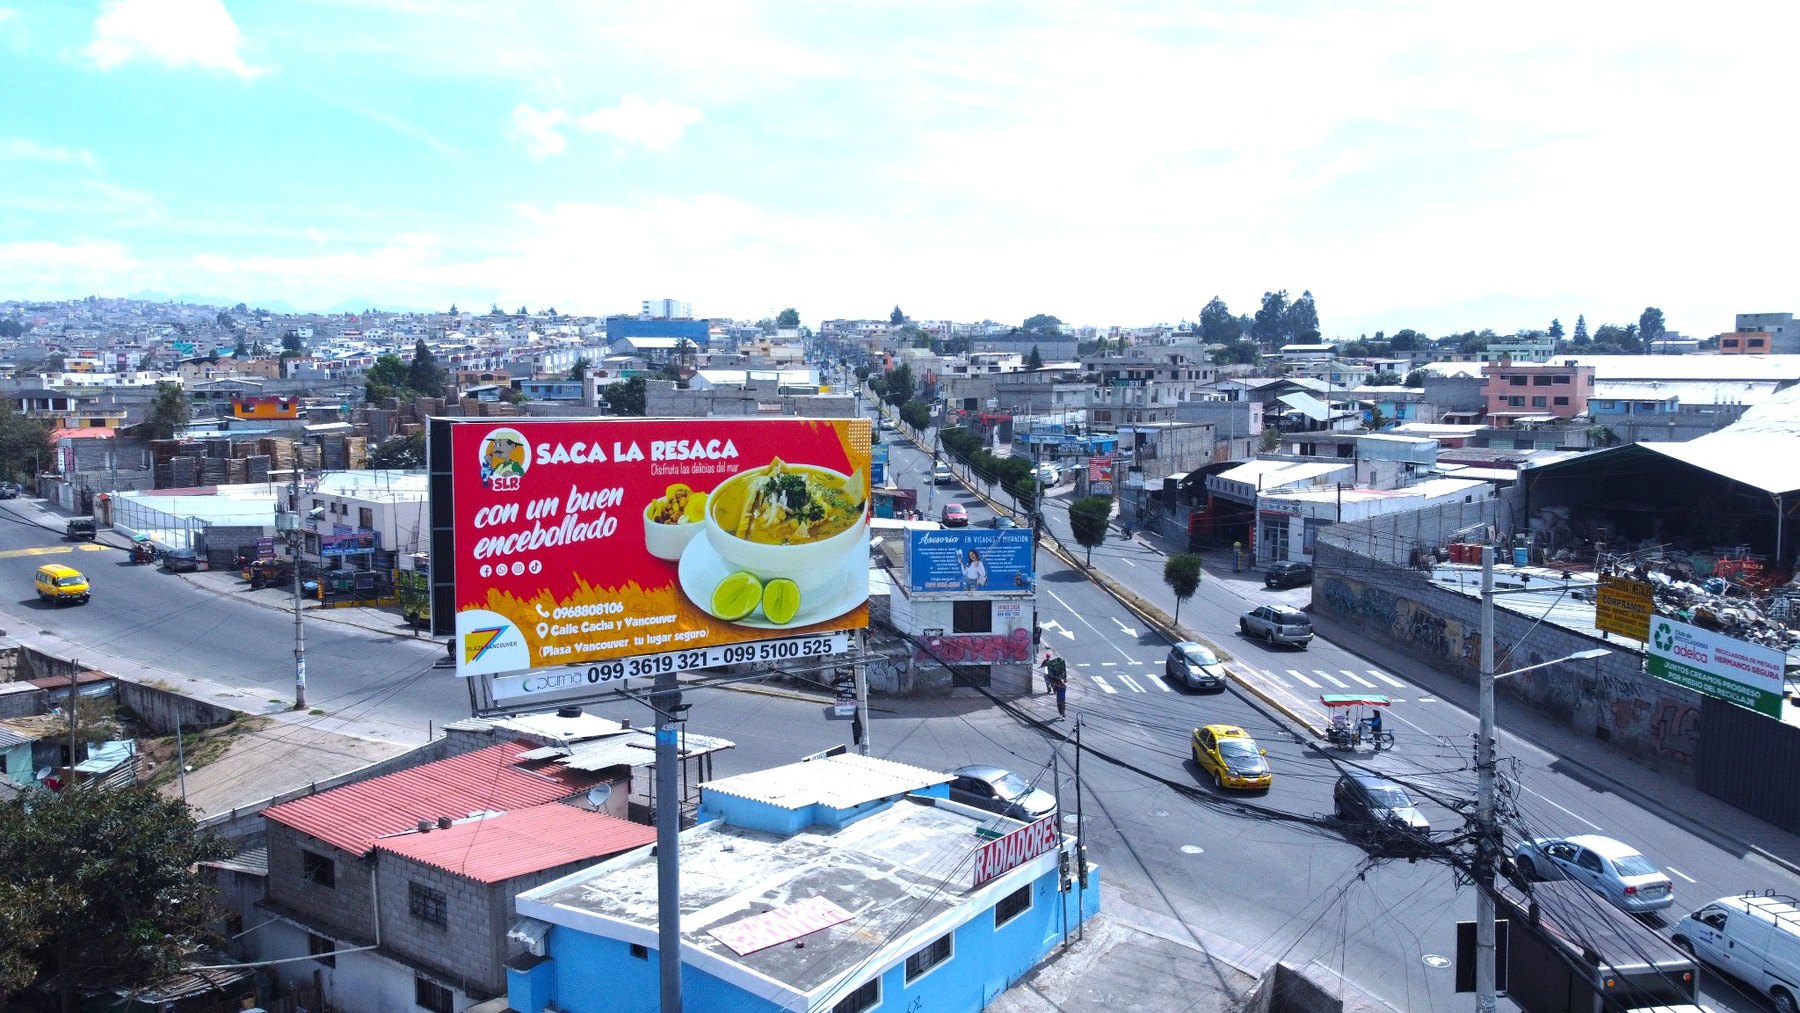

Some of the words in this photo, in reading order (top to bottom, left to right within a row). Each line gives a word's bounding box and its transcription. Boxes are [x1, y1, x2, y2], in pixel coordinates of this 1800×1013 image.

[536, 441, 608, 465] SACA
[613, 440, 645, 463] LA
[651, 438, 739, 462] RESACA
[651, 462, 679, 476] Disfruta
[680, 462, 690, 474] las
[691, 461, 715, 474] delicias
[716, 461, 726, 473] del
[726, 464, 740, 472] mar
[494, 477, 519, 490] SLR
[473, 503, 519, 529] con
[525, 496, 560, 521] un
[565, 484, 624, 513] buen
[473, 511, 618, 560] encebollado
[964, 535, 972, 543] EN
[552, 601, 624, 619] 0968808106
[1602, 595, 1646, 614] COMPRAMOS
[550, 623, 579, 637] Calle
[581, 619, 614, 633] Cacha
[616, 621, 622, 631] y
[624, 613, 677, 628] Vancouver
[633, 635, 644, 646] tu
[646, 633, 672, 645] lugar
[587, 662, 624, 683] 099
[628, 655, 673, 677] 3619
[677, 651, 708, 670] 321
[723, 645, 756, 664] 099
[760, 641, 799, 660] 5100
[803, 638, 832, 655] 525
[1673, 644, 1708, 664] adelca
[1757, 659, 1780, 671] METALES
[1664, 661, 1690, 675] JUNTOS
[1689, 669, 1722, 686] CREAMOS
[1722, 680, 1761, 699] PROGRESO
[1714, 655, 1751, 672] HERMANOS
[1752, 666, 1780, 681] SEGURA
[1668, 671, 1681, 681] POR
[1682, 676, 1703, 689] MEDIO
[1704, 683, 1716, 693] DEL
[1717, 688, 1756, 707] RECICLAJE
[974, 813, 1058, 885] RADIADORES
